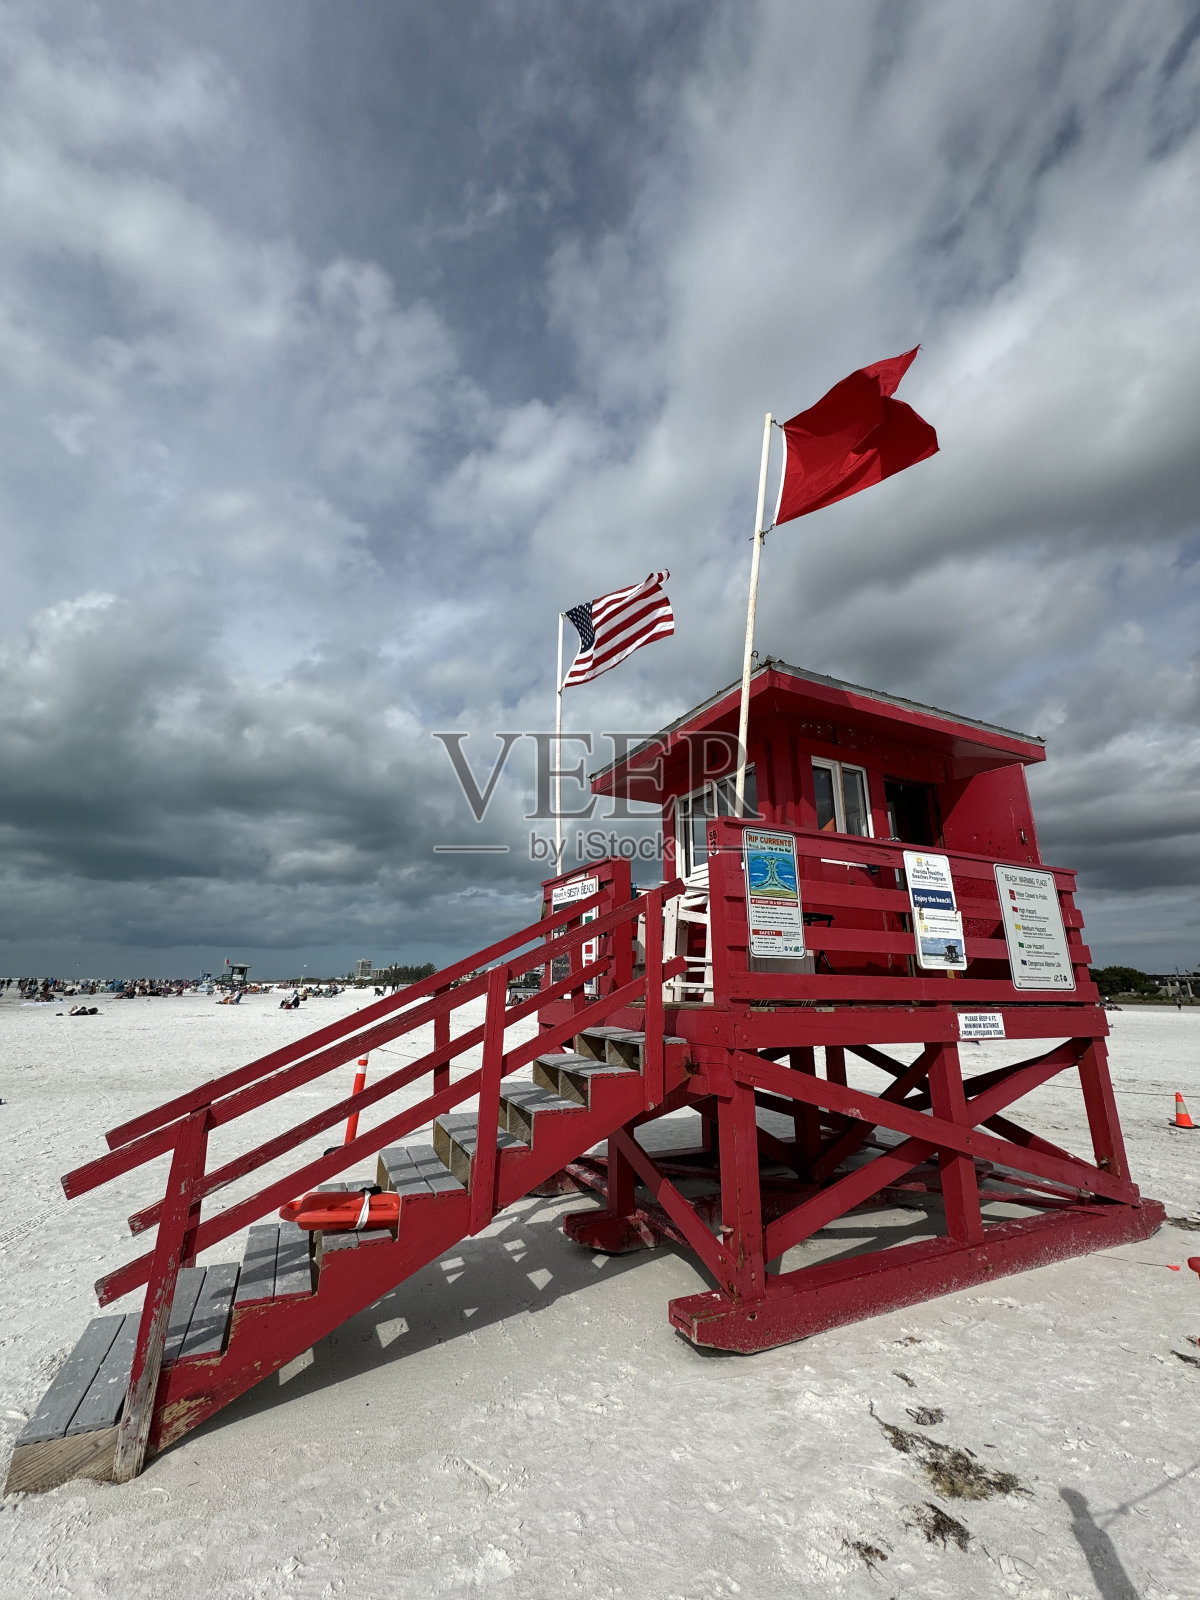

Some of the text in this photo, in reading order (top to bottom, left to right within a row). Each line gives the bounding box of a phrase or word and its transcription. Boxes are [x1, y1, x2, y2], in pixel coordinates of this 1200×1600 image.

[748, 834, 792, 847] RIP CURRENTS
[1019, 876, 1035, 885] WARNING
[1036, 879, 1047, 887] FLAGS
[581, 883, 594, 894] BEACH
[914, 895, 928, 903] Enjoy
